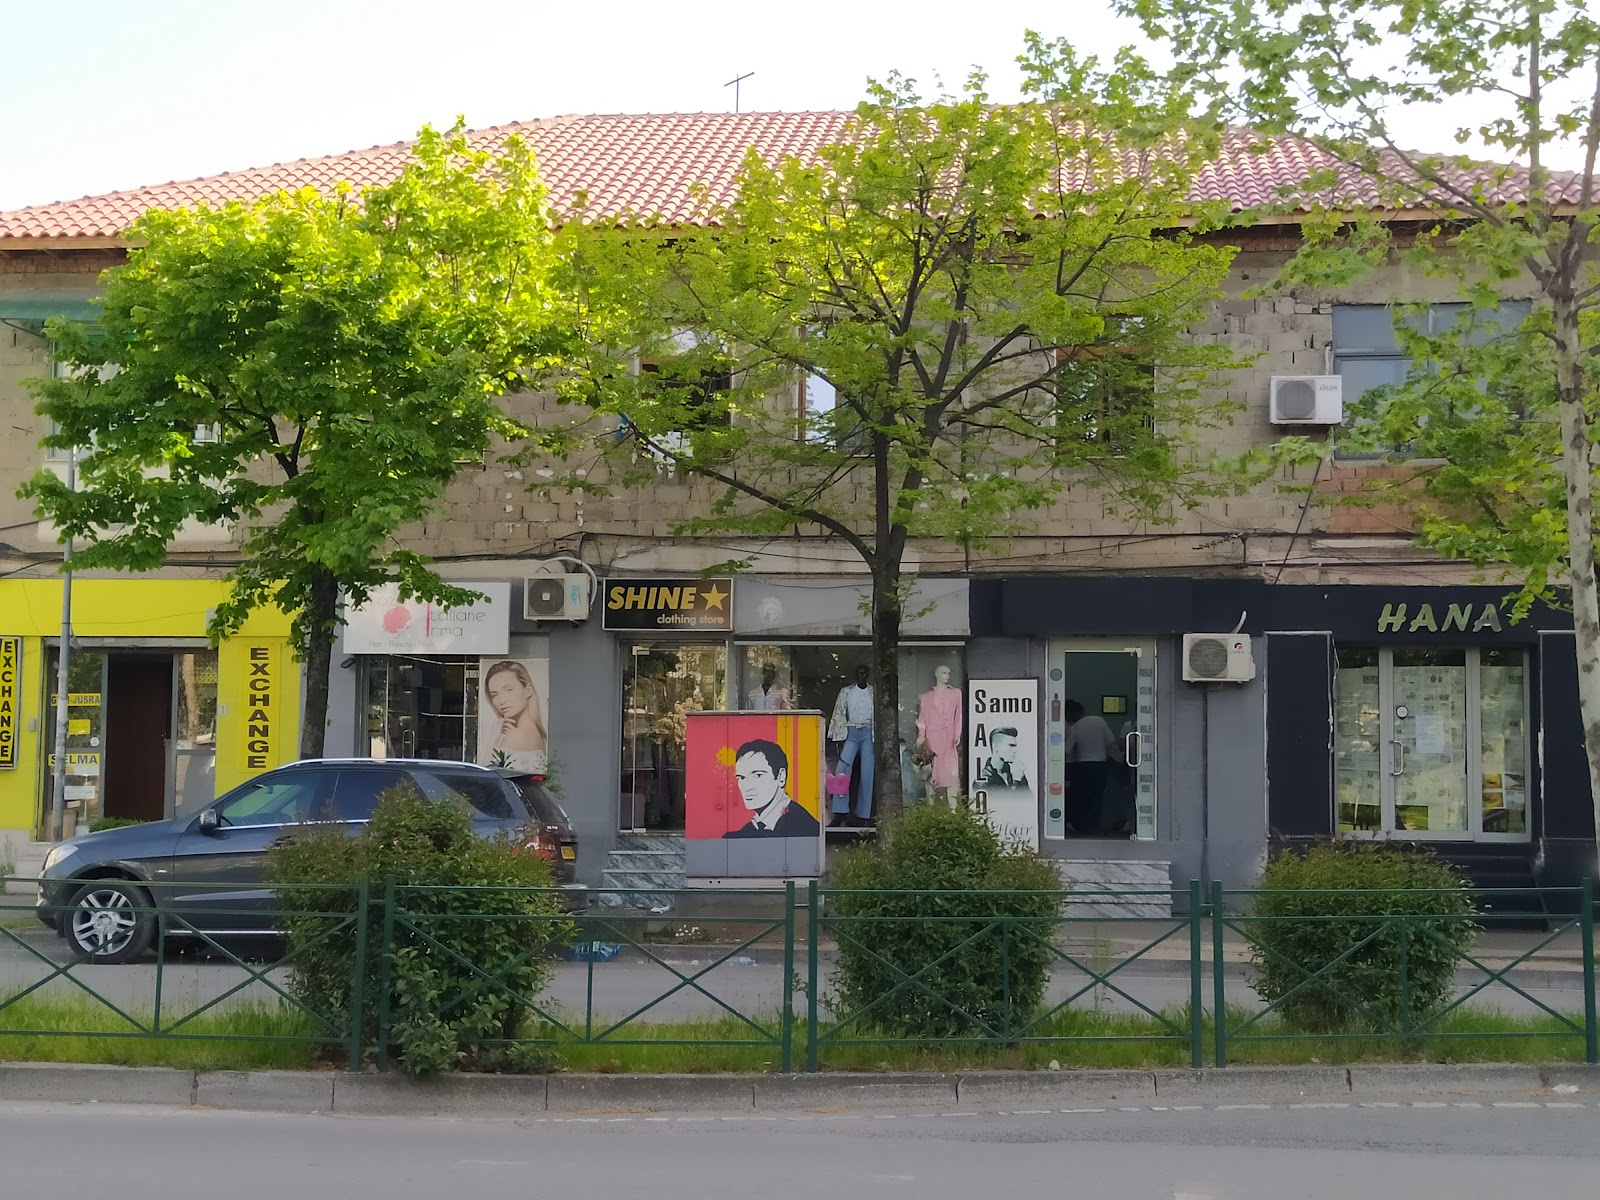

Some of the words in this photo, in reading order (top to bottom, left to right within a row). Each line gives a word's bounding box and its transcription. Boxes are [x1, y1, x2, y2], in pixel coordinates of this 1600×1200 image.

[607, 586, 697, 610] SHINE
[656, 613, 697, 626] clothing
[699, 614, 724, 625] store
[1377, 603, 1503, 633] HANA
[0, 641, 13, 757] EXCHANGE
[247, 647, 271, 769] EXCHANGE
[974, 689, 1033, 714] Samo
